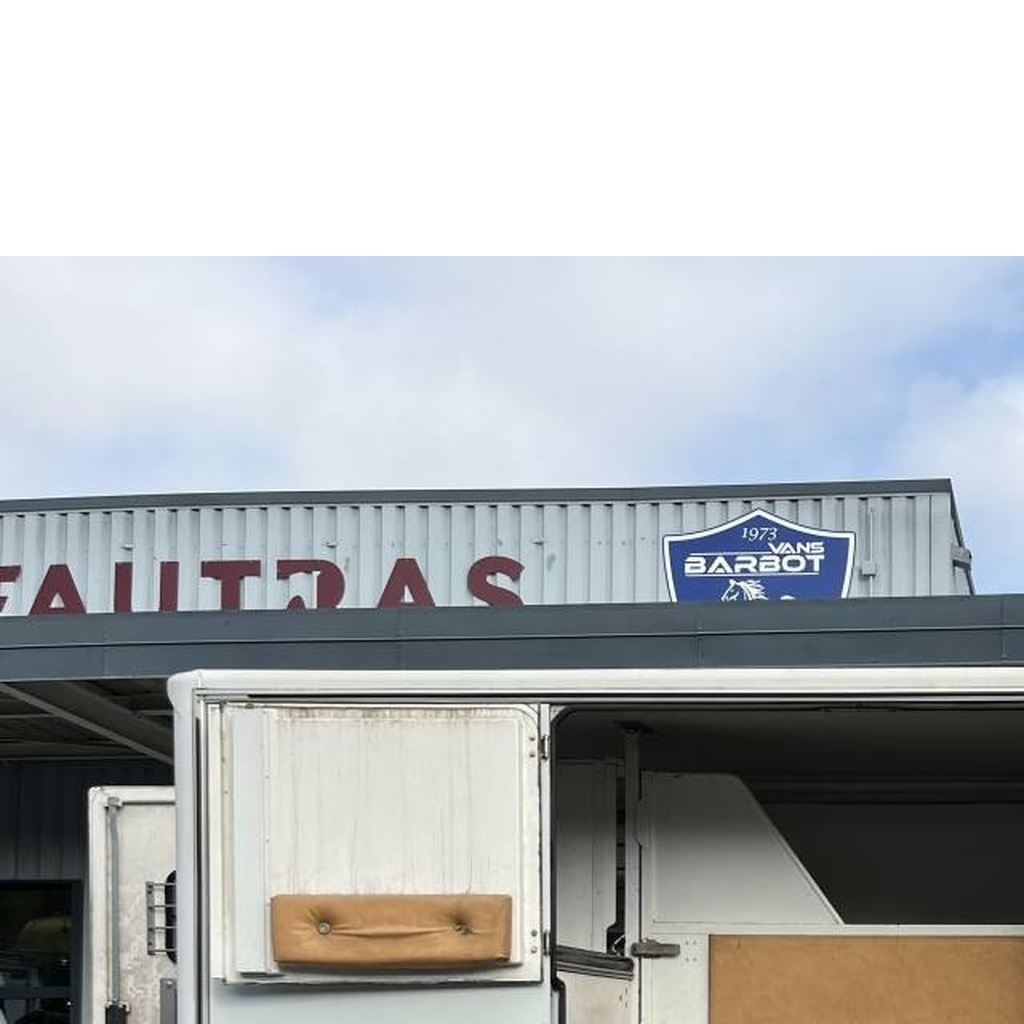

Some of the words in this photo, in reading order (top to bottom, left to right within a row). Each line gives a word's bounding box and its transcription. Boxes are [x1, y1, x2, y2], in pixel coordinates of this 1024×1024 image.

[741, 527, 778, 542] 1973
[767, 541, 825, 555] VANS
[684, 554, 825, 574] BARBOT
[0, 556, 525, 616] AUTRAS
